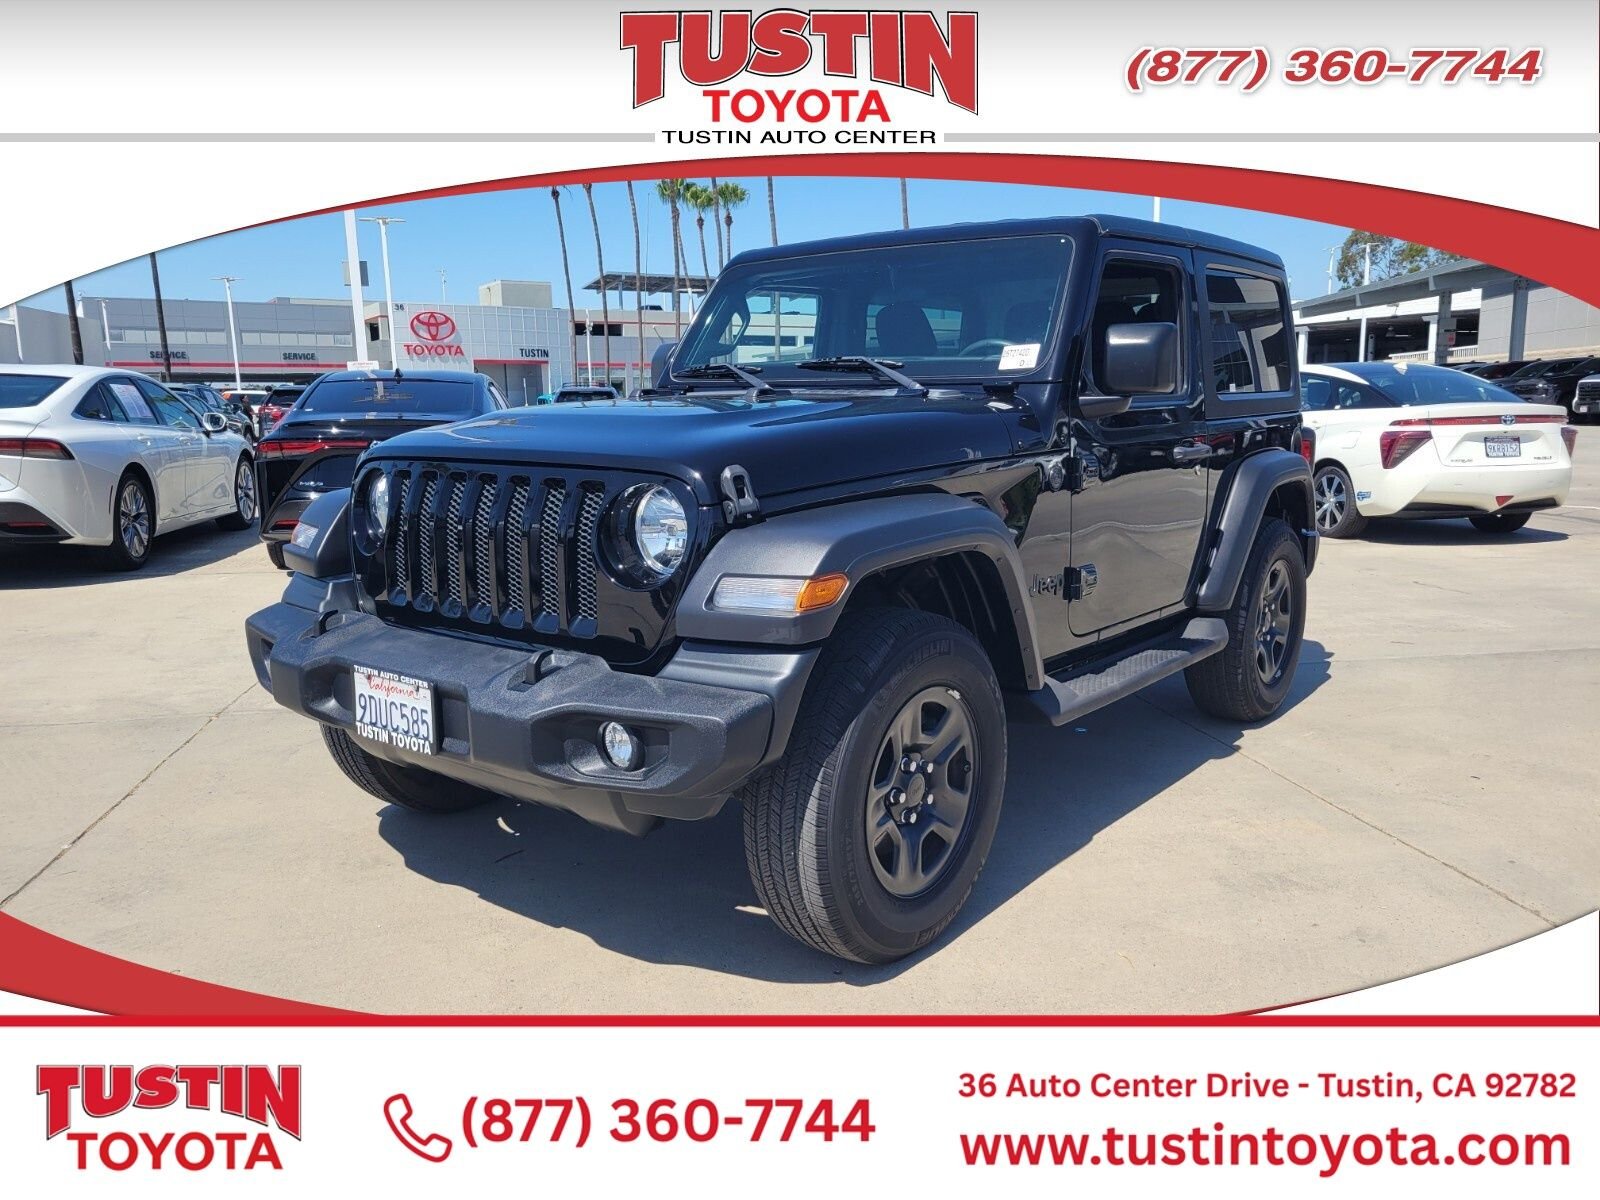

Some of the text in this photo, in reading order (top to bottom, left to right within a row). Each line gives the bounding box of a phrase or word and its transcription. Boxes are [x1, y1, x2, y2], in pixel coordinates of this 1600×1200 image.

[282, 352, 317, 361] SERVICE
[403, 344, 465, 356] TOYOTA
[519, 348, 549, 358] TUSTIN
[1028, 573, 1064, 598] Jeep
[353, 664, 429, 689] TUSTIN AUTO CENTER
[357, 692, 430, 741] 9DUC585
[355, 722, 432, 755] TUSTIN TOYOTA
